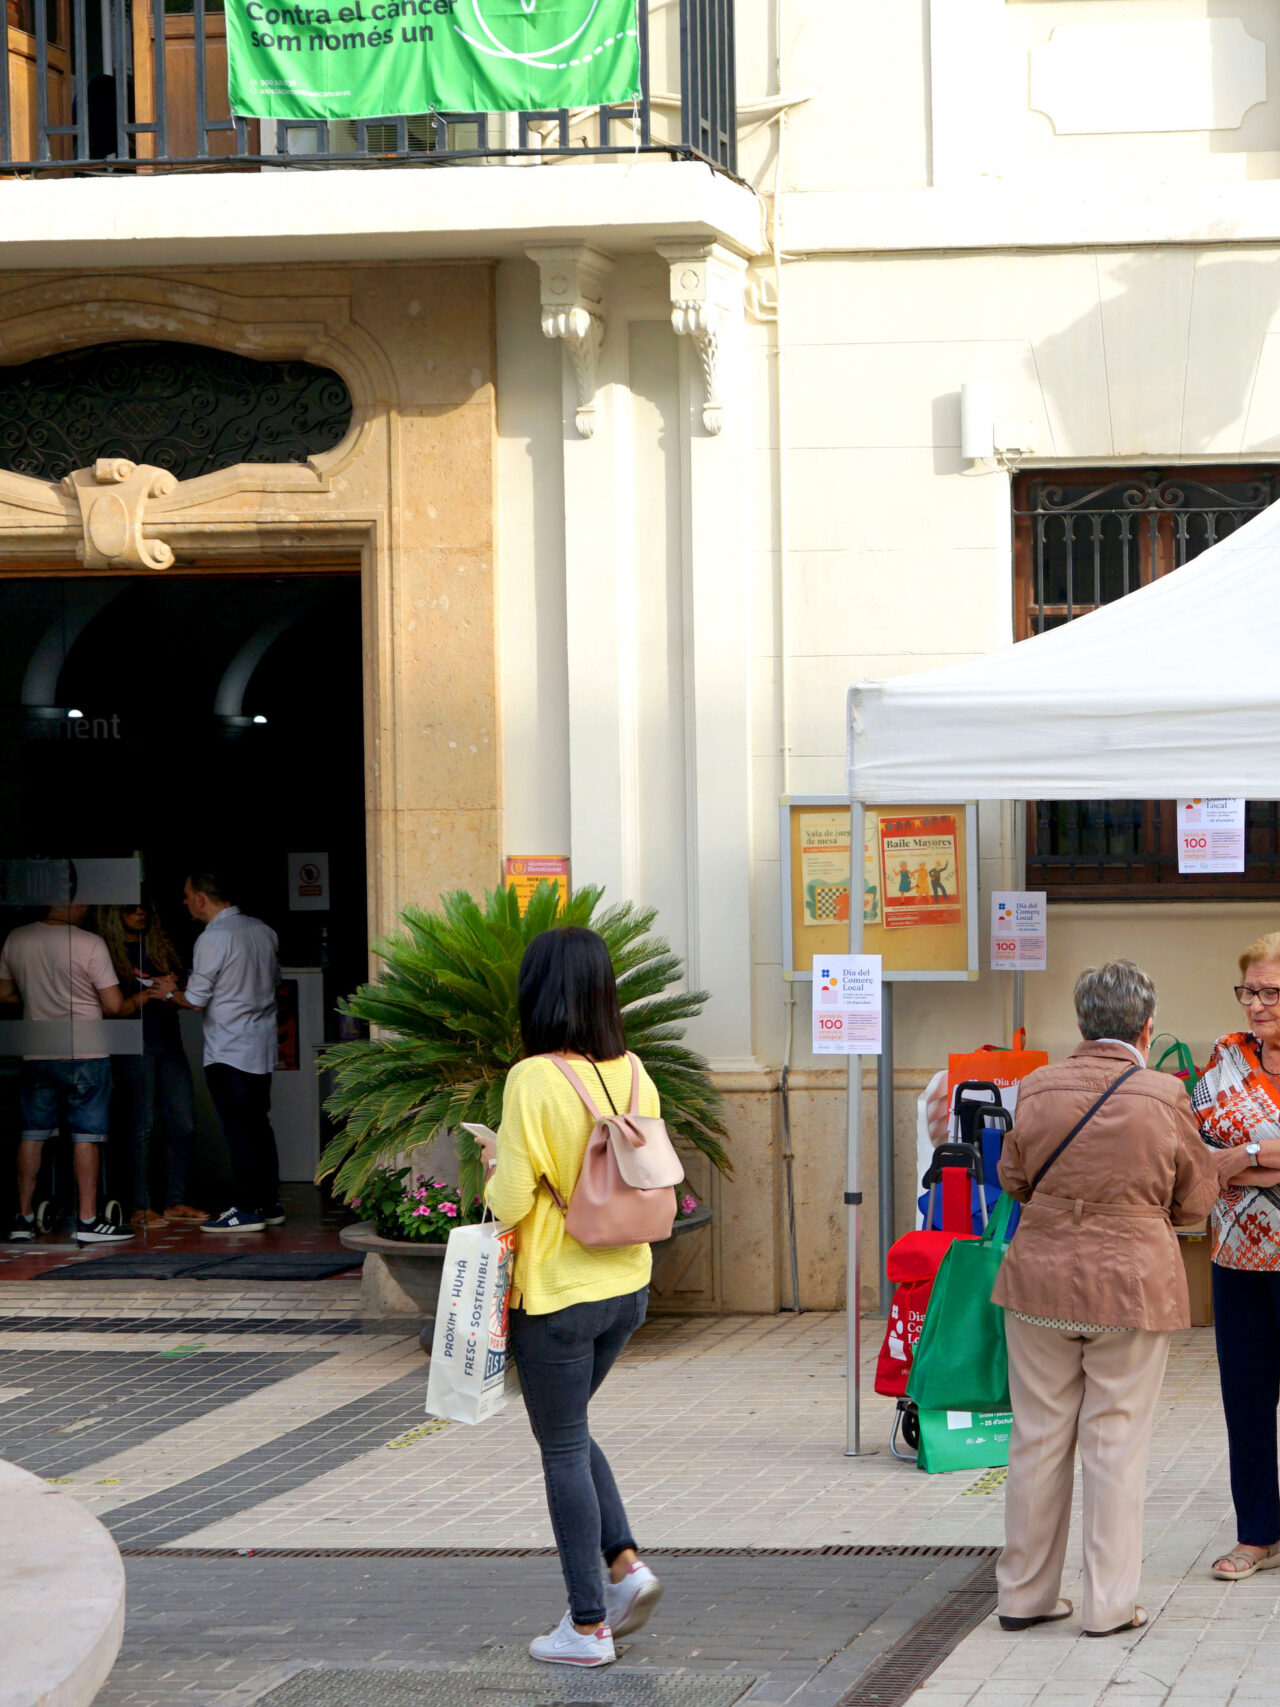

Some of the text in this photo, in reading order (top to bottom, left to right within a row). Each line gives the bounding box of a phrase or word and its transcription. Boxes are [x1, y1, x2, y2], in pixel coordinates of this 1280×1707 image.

[246, 0, 330, 25] Contra
[338, 0, 366, 22] el
[251, 24, 434, 51] som només un
[825, 829, 834, 837] de
[886, 838, 952, 849] Baile Mayores
[1184, 838, 1207, 849] 100
[996, 943, 1017, 951] 100
[843, 977, 873, 985] Comerç
[819, 1019, 842, 1029] 100
[994, 1078, 1009, 1086] Dia
[464, 1252, 489, 1377] FRESC SOSTENIBLE
